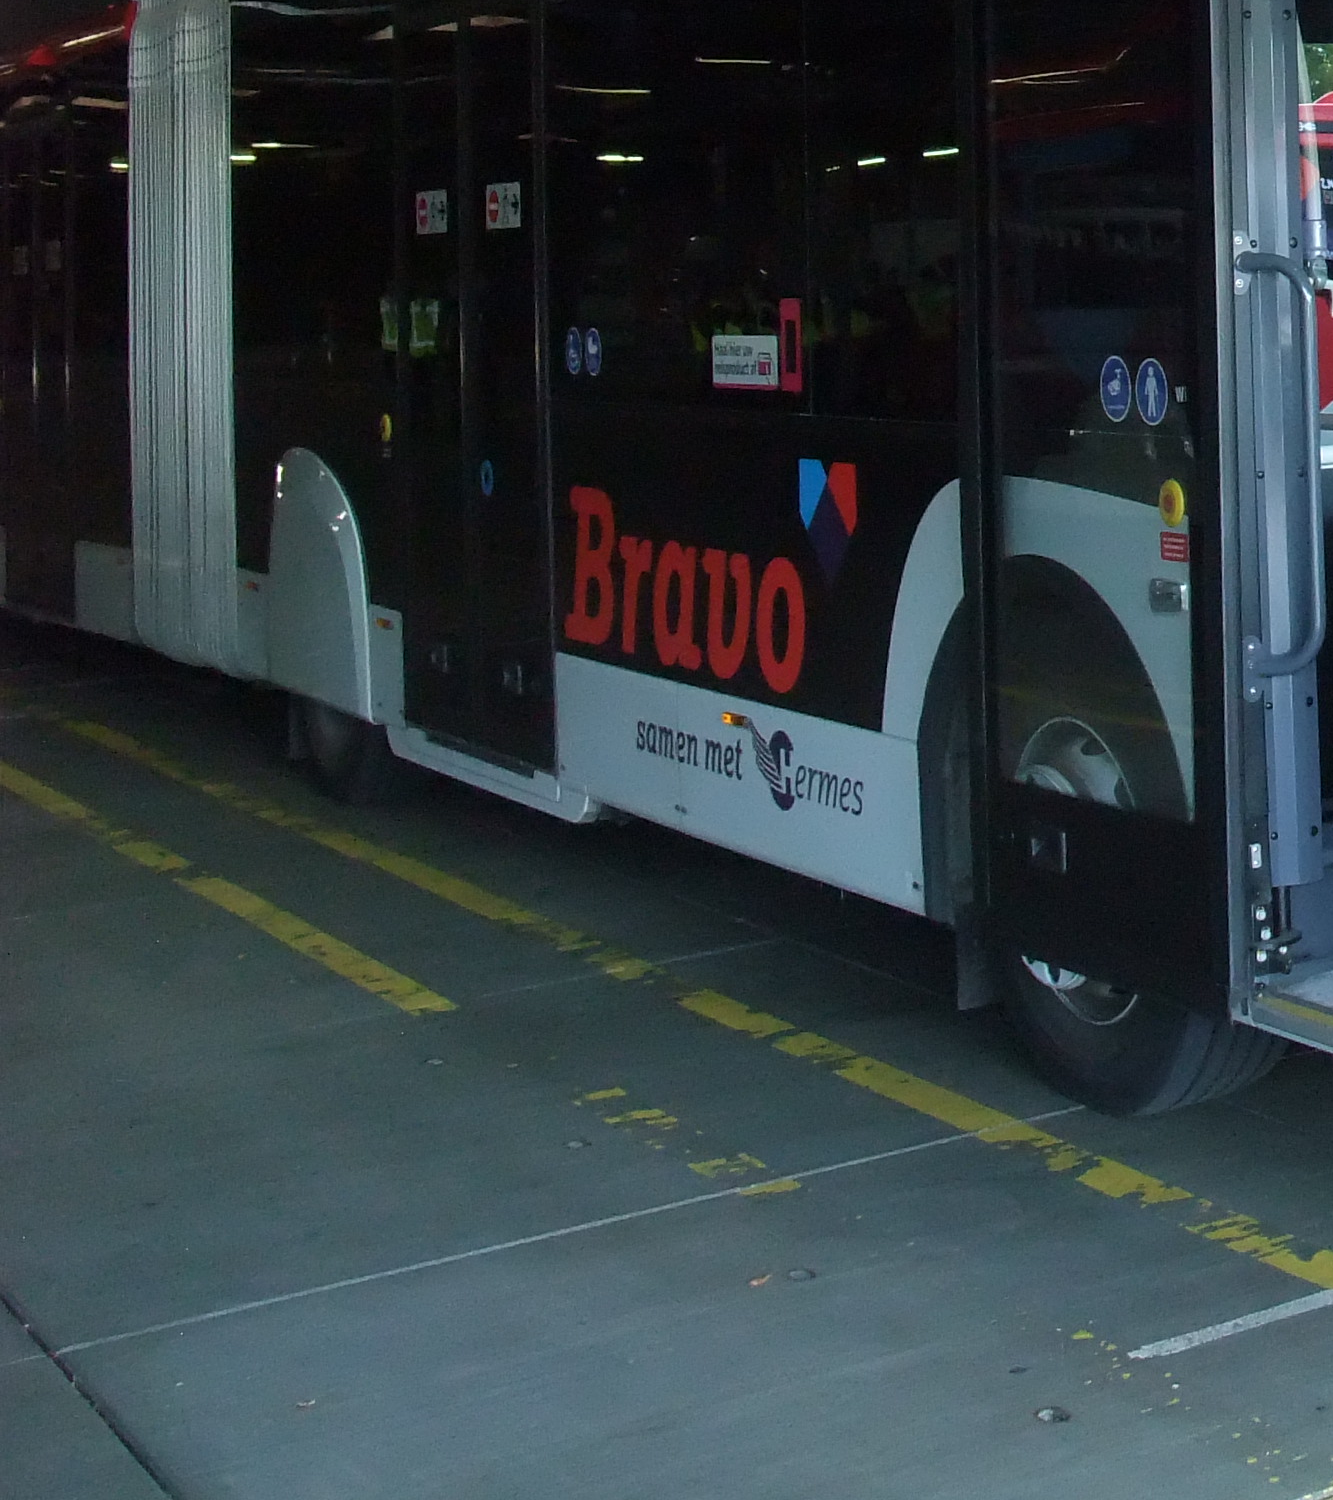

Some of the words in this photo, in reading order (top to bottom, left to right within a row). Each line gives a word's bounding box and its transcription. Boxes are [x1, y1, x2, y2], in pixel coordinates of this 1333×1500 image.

[563, 484, 806, 694] Bravo
[635, 719, 698, 768] samen
[704, 738, 743, 781] met
